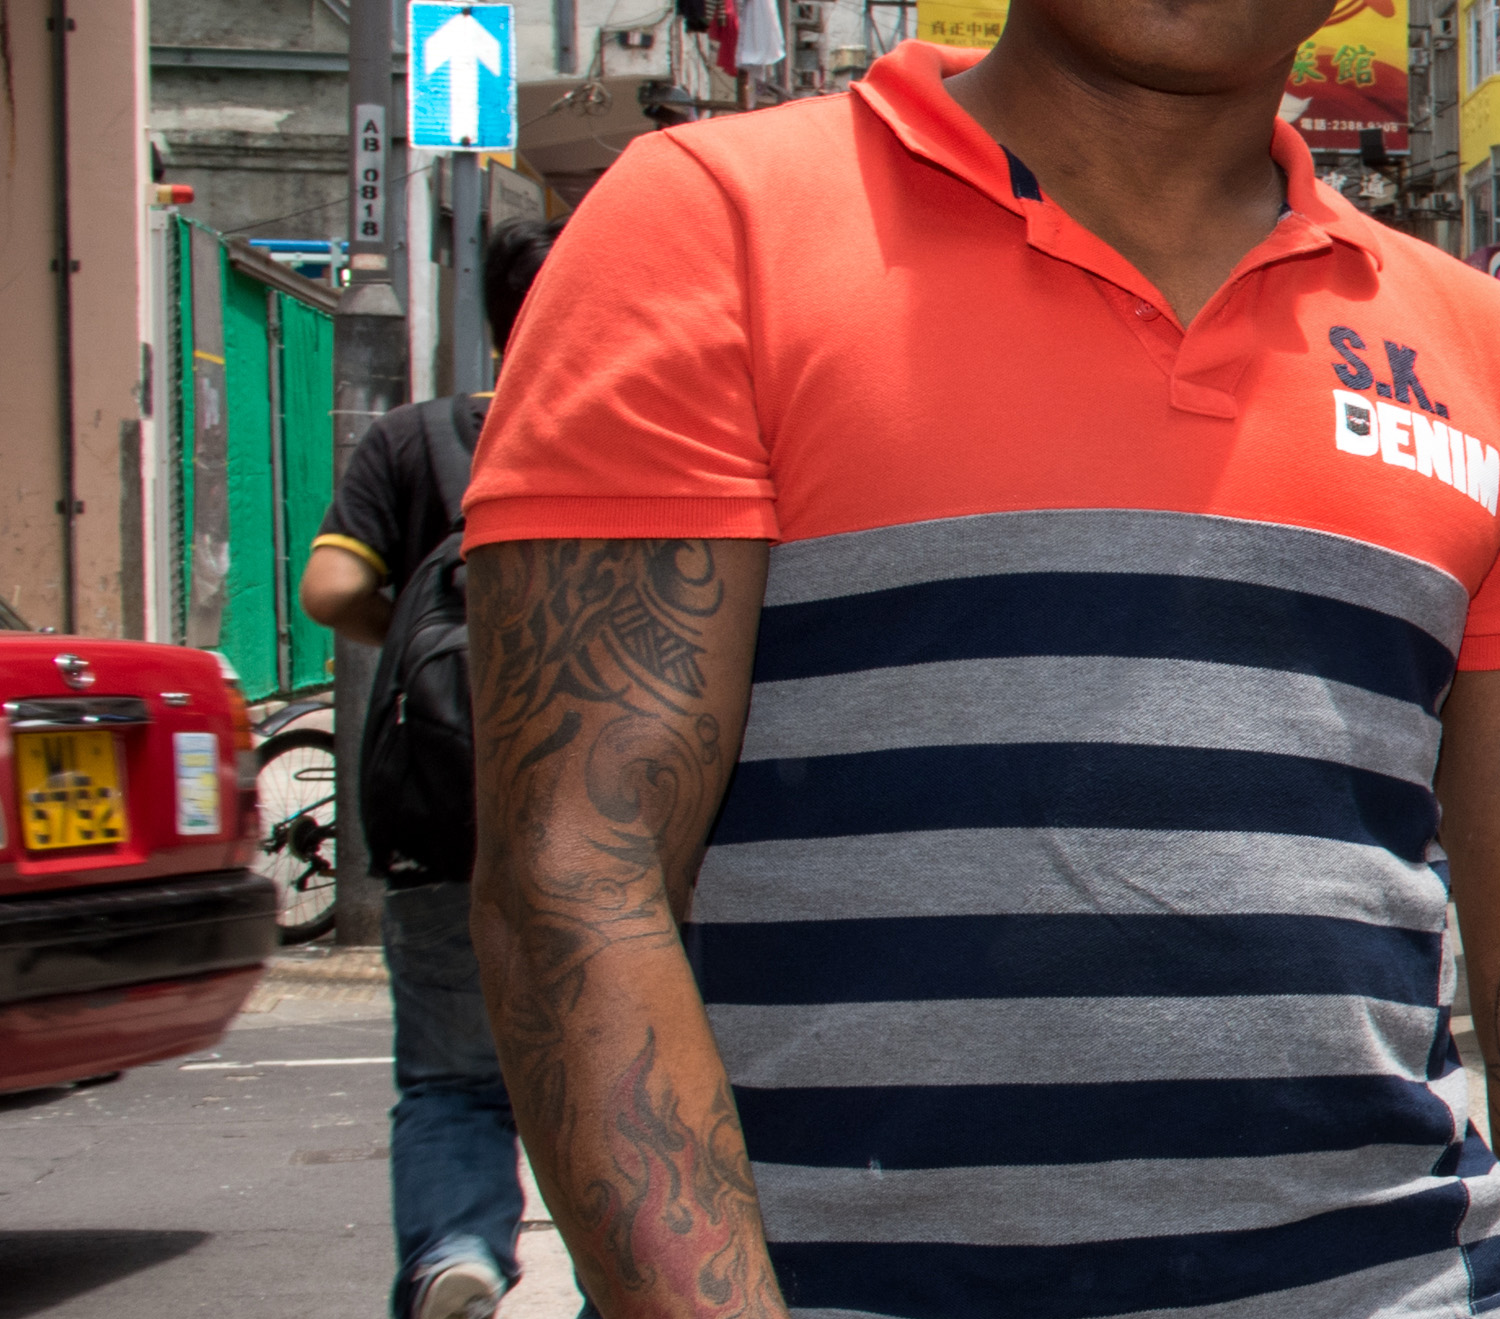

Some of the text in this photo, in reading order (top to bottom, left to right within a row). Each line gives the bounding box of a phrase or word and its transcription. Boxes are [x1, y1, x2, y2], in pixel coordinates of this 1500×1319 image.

[361, 119, 380, 236] AB 0818
[1328, 325, 1450, 420] S.K.
[1332, 388, 1500, 517] DENIM
